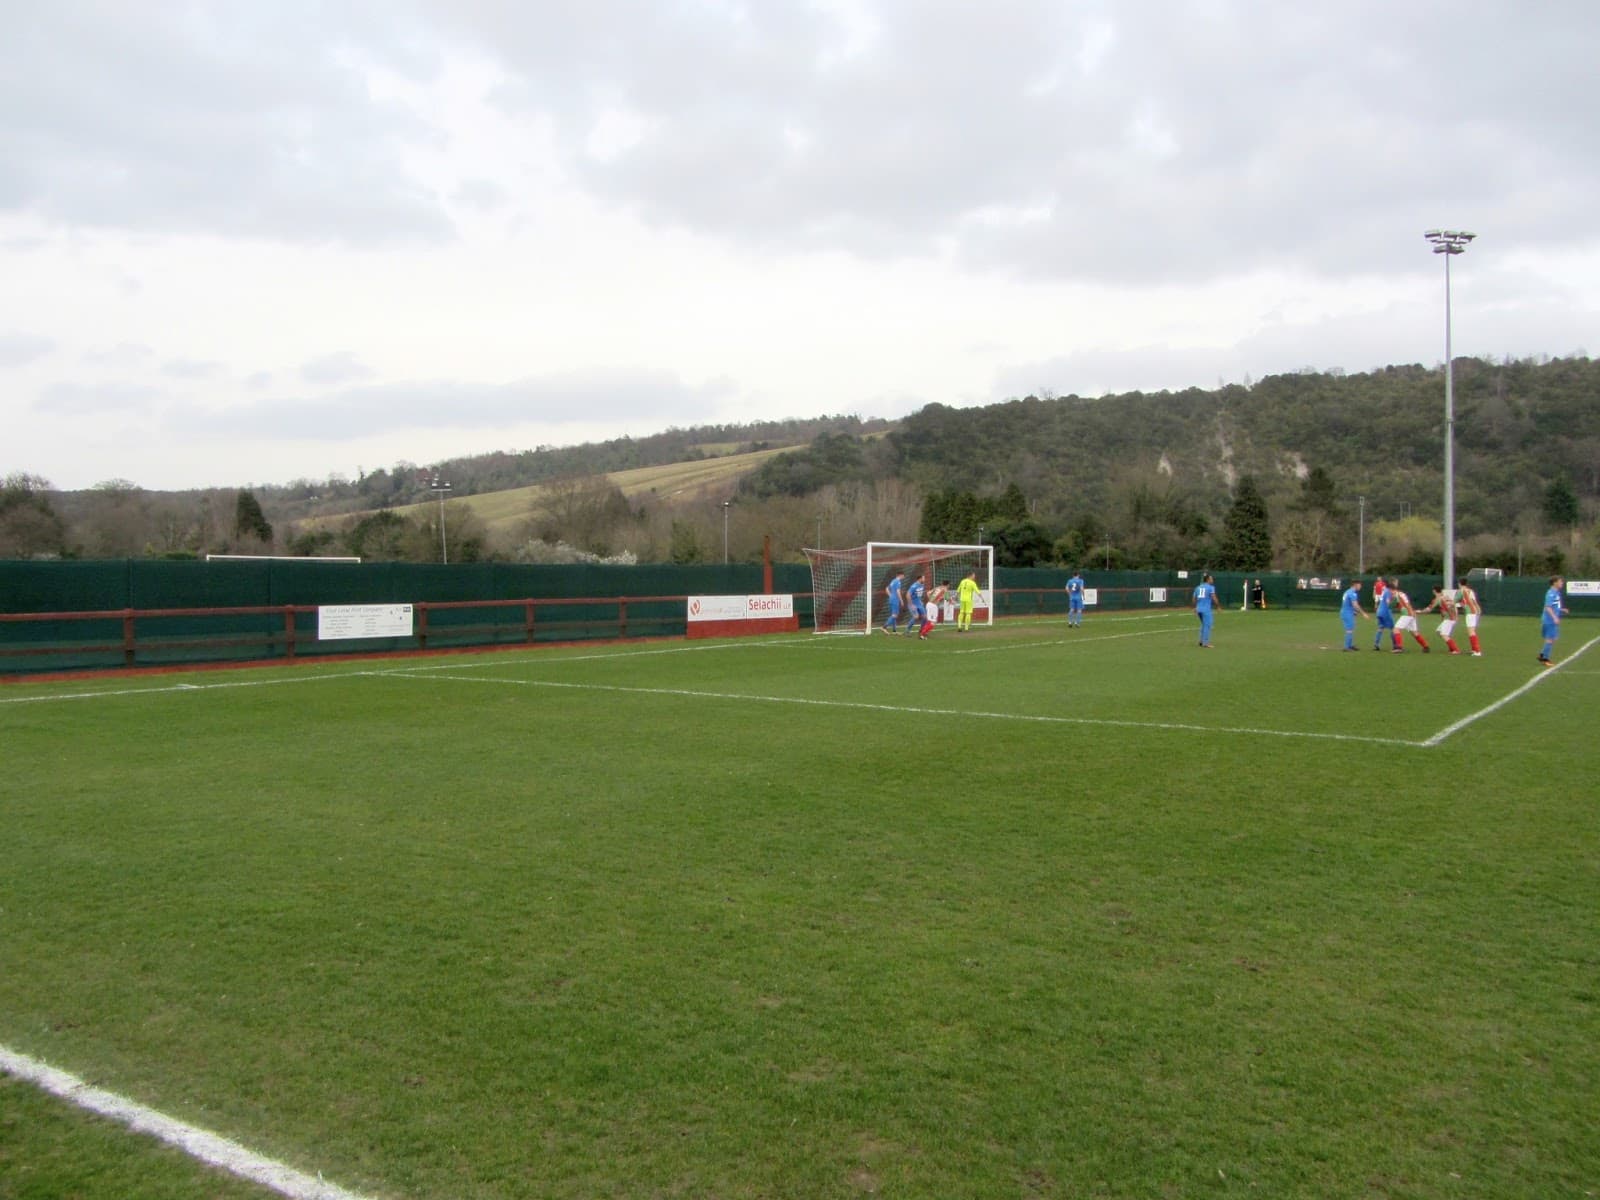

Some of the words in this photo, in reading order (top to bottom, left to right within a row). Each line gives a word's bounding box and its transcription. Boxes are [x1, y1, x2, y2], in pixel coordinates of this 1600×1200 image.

[1071, 582, 1077, 591] 2
[1197, 587, 1206, 599] 11
[748, 597, 782, 611] Selachii
